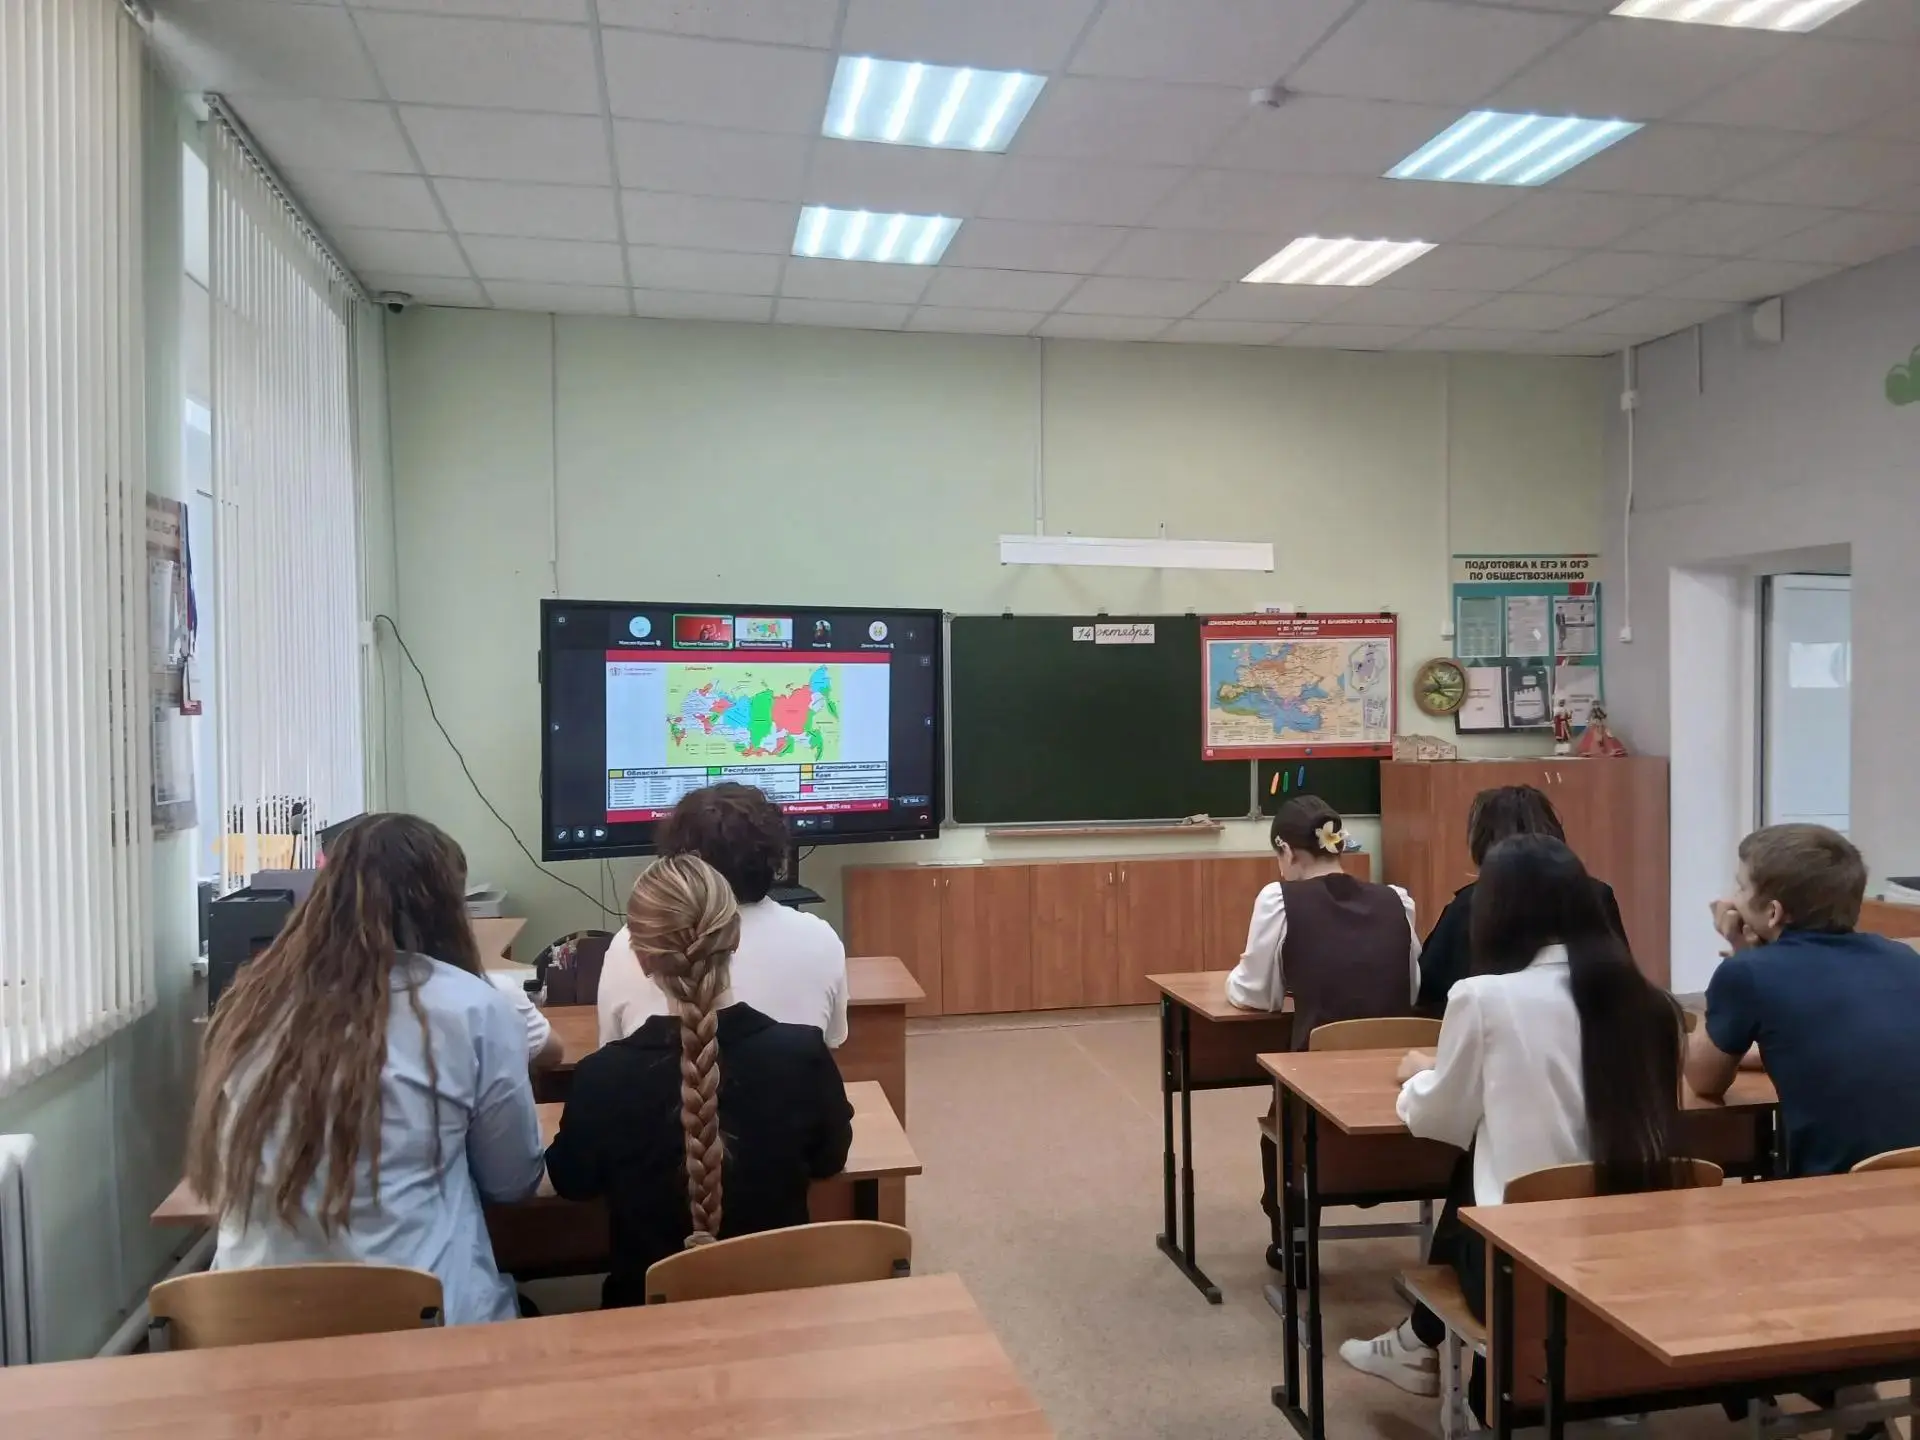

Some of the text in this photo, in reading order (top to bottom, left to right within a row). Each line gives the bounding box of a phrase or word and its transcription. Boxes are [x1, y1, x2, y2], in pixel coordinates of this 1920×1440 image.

[1465, 560, 1528, 570] ПОДГОТОВКА
[1470, 572, 1584, 581] ПО ОБЩЕСТВОЗНАНИЮ
